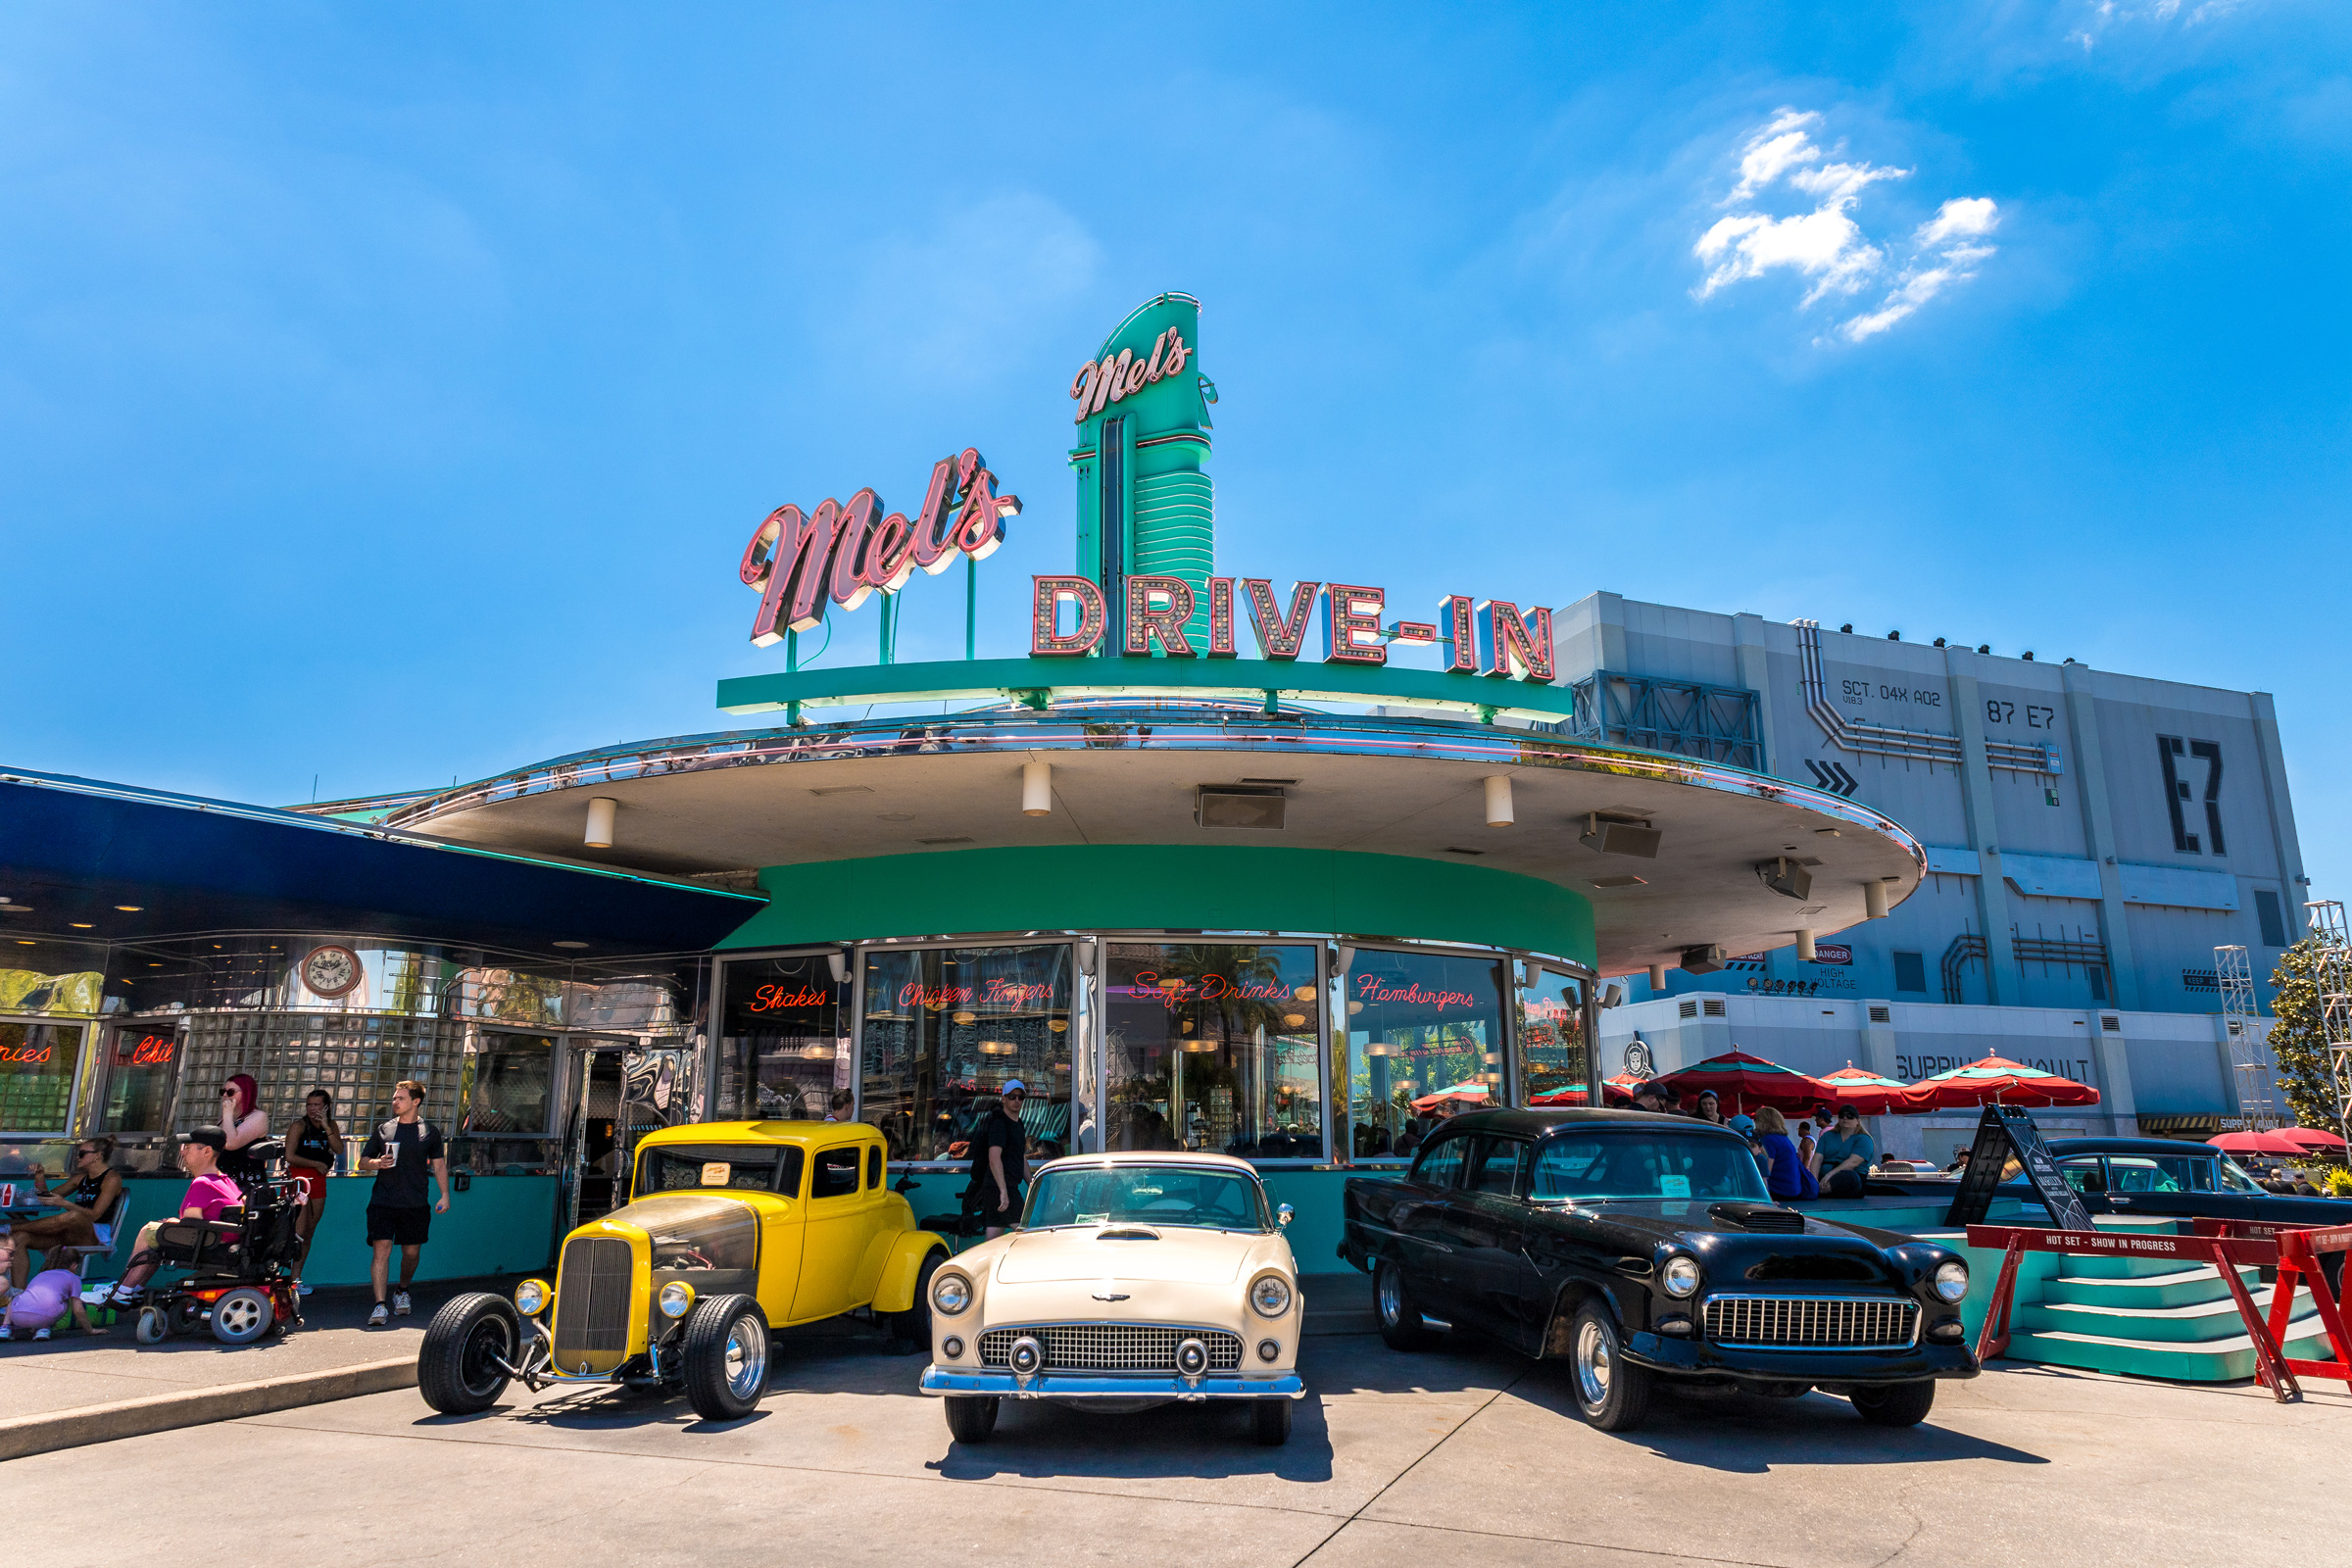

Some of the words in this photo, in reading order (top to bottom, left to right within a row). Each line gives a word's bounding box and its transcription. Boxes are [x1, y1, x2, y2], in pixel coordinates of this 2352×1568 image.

[1070, 326, 1194, 424] Mel's
[740, 447, 1023, 648] Mel's
[1031, 574, 1554, 685] DRIVE-IN
[1842, 679, 1875, 698] SCT.
[1986, 700, 2015, 725] 87
[2027, 705, 2054, 730] E7
[2156, 733, 2228, 858] E7
[1128, 971, 1197, 1008] Soft
[1200, 974, 1290, 1000] Drinks
[1820, 967, 1844, 978] HIGH
[751, 984, 827, 1011] Shakes
[899, 982, 973, 1006] Chicken
[979, 978, 1054, 1012] Fingers
[1357, 973, 1473, 1011] Hamburgers
[2220, 1118, 2252, 1129] SUPPY
[2046, 1235, 2062, 1245] HOT
[2065, 1236, 2081, 1246] SET
[2091, 1238, 2116, 1249] SHOW
[2119, 1239, 2128, 1249] IN
[2131, 1240, 2176, 1251] PROGRESS
